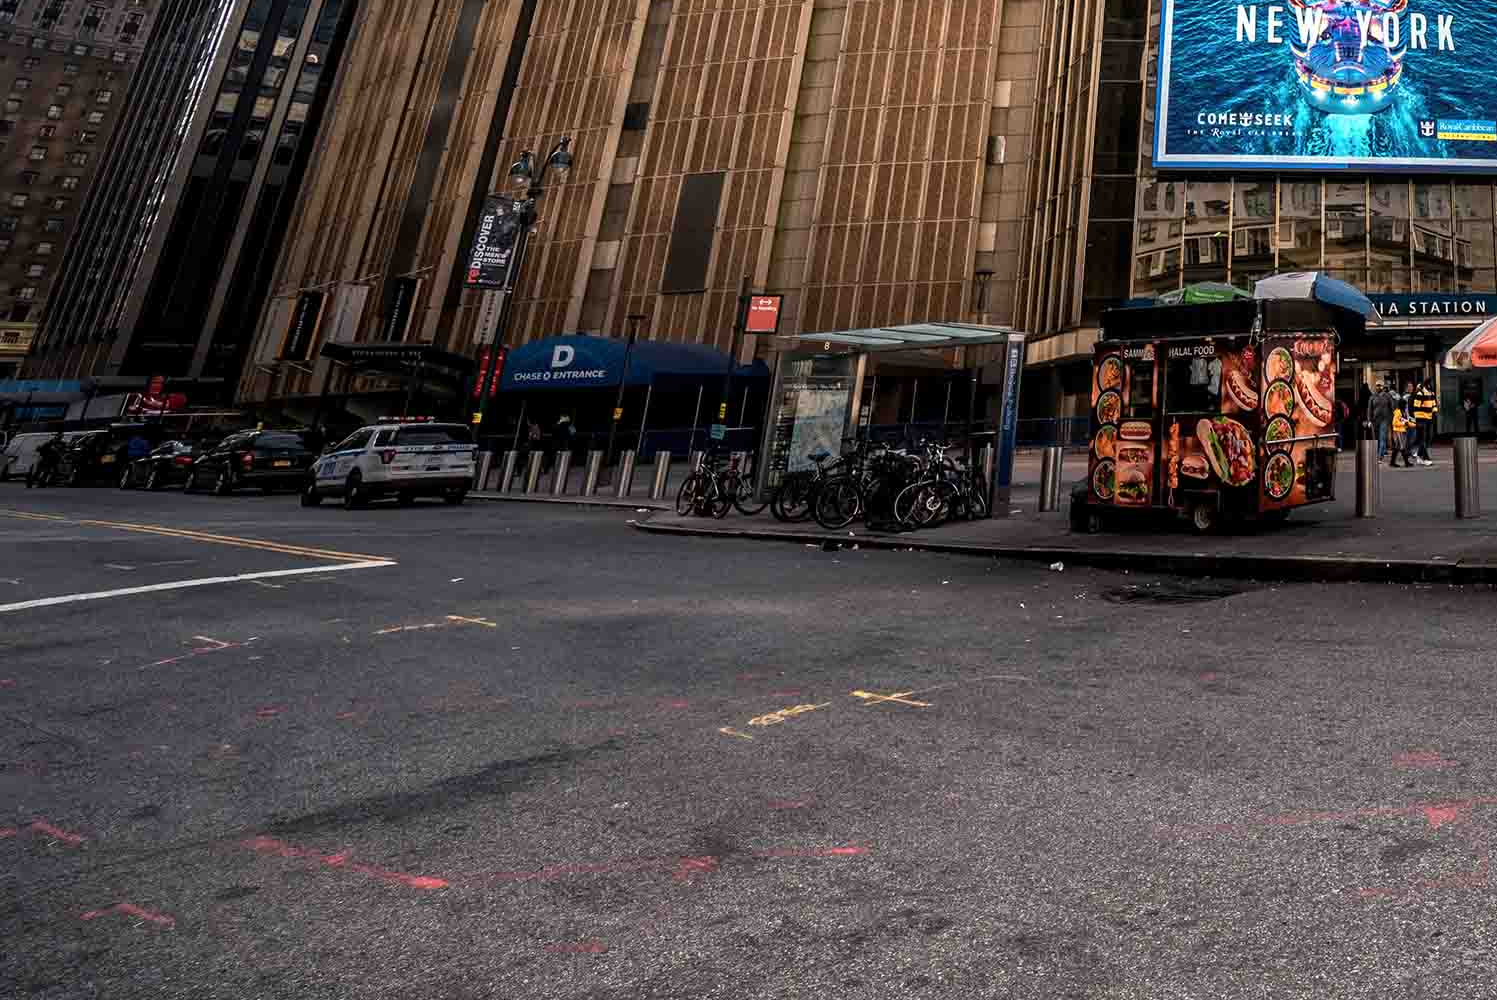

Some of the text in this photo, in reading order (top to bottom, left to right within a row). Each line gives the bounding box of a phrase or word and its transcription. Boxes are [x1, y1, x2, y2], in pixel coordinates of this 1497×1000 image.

[1236, 5, 1455, 51] NEW YORK
[1197, 112, 1293, 126] COME SEEK
[1409, 301, 1486, 315] STATION
[552, 344, 576, 369] D
[1167, 347, 1193, 358] HALAL
[1194, 345, 1215, 356] FOOD
[513, 370, 608, 381] CHASE ENTRANCE
